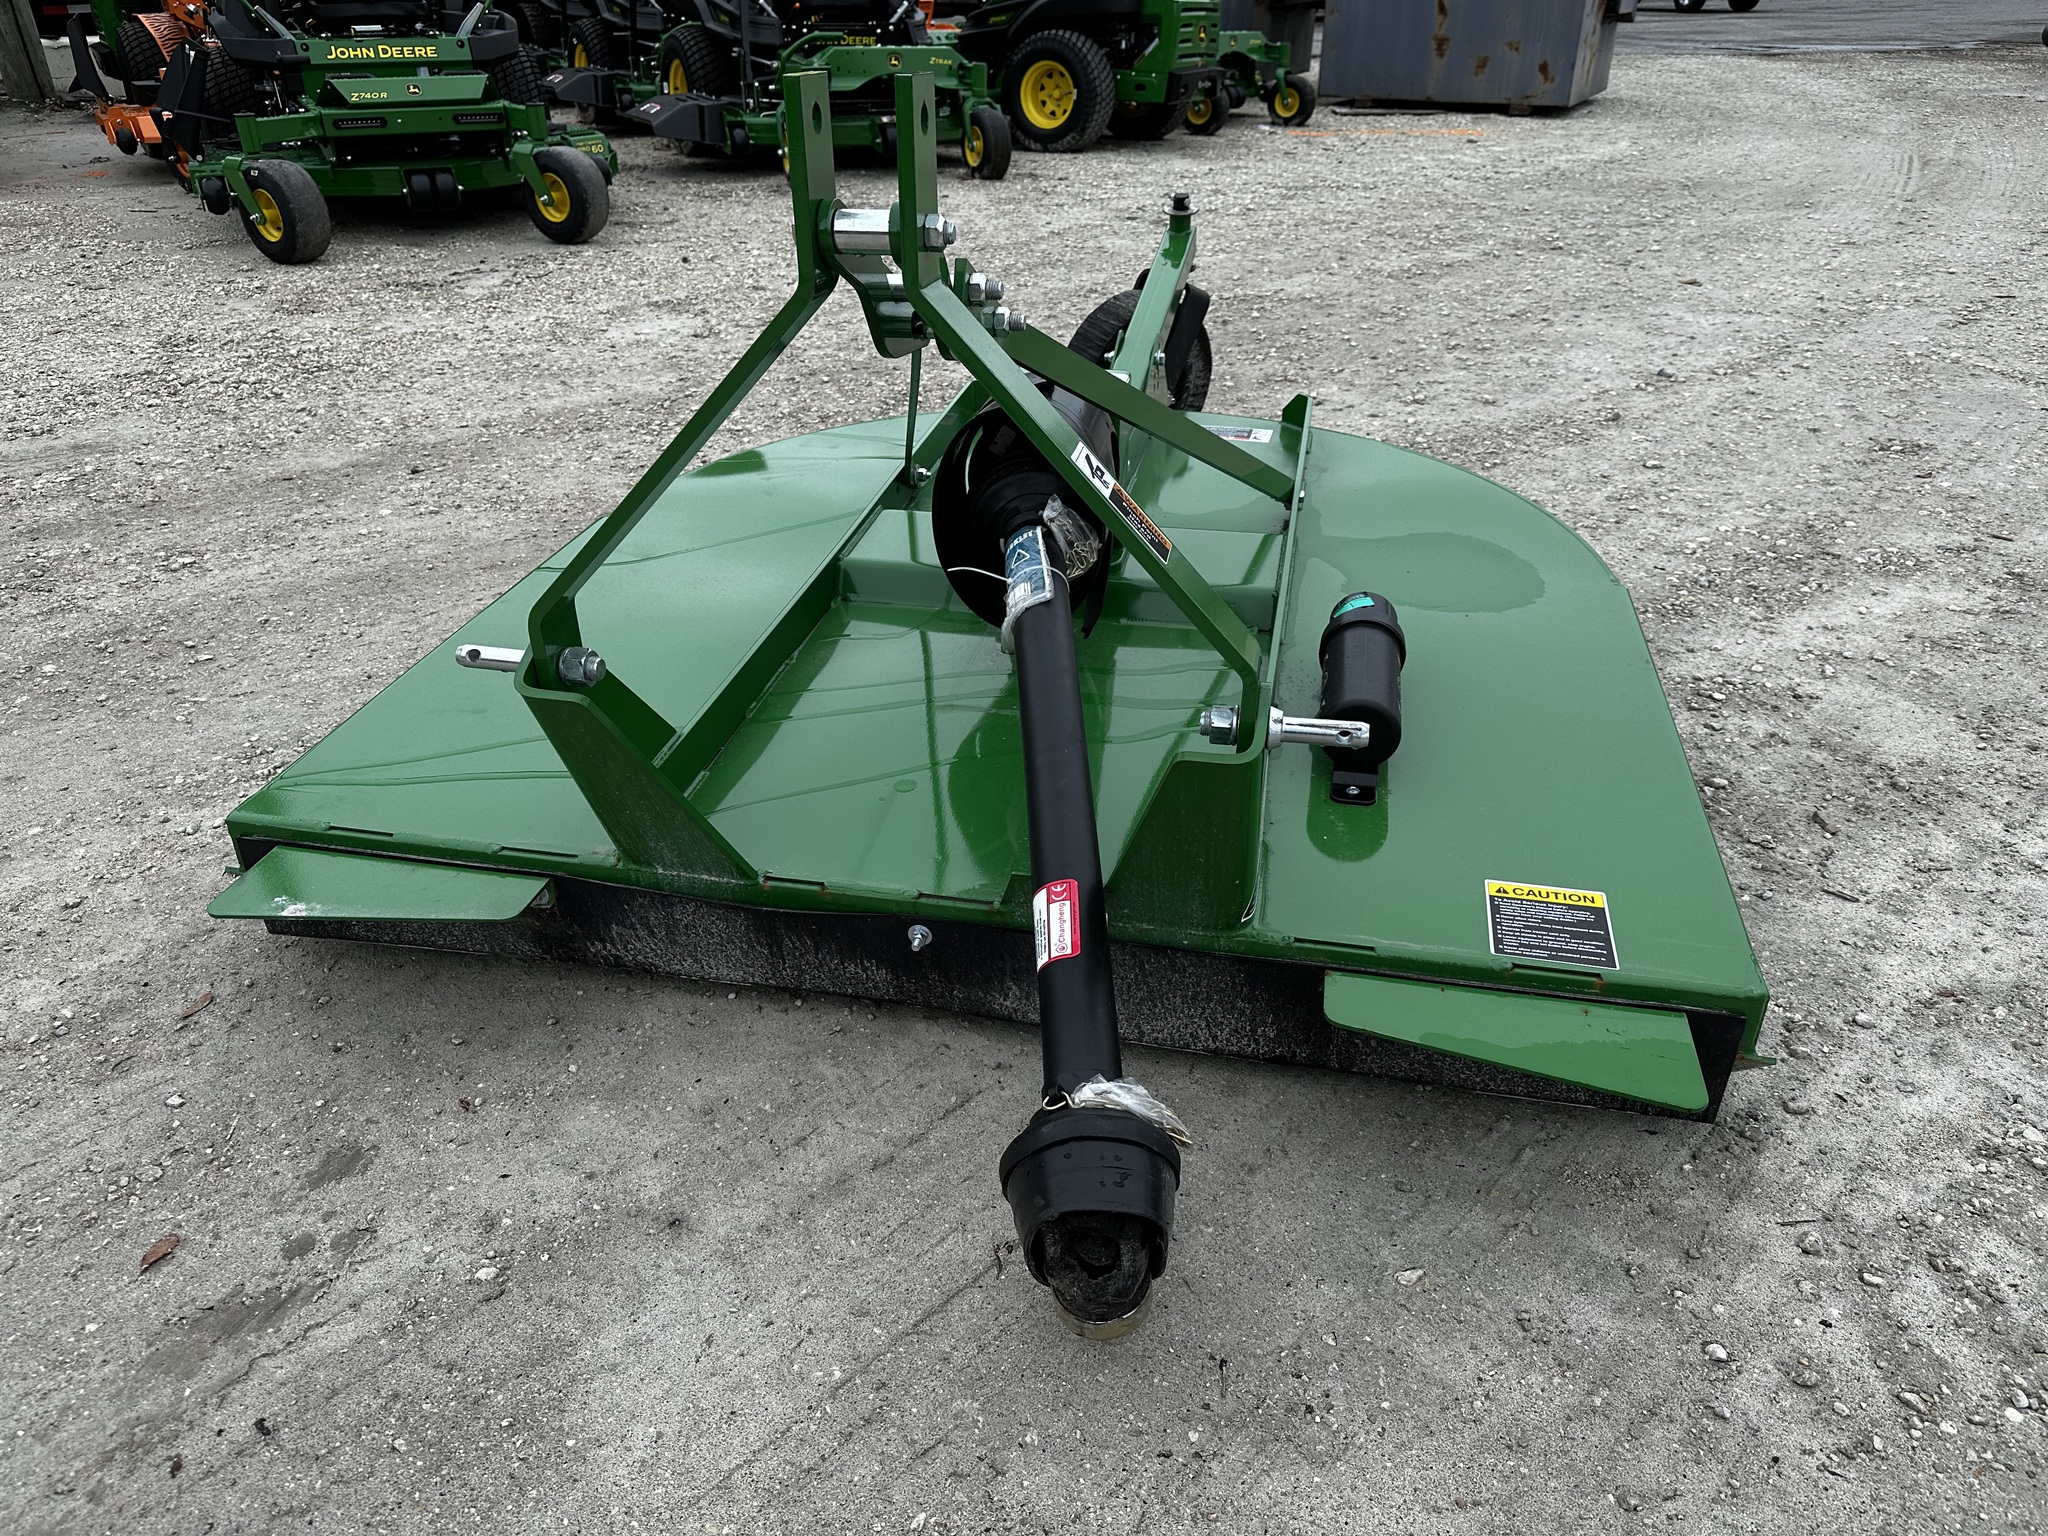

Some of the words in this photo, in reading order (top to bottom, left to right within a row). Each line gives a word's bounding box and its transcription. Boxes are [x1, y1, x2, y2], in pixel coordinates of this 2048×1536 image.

[326, 45, 375, 59] JOHN
[377, 44, 438, 58] DEERE
[591, 144, 604, 153] 60
[1512, 887, 1595, 904] CAUTION
[1057, 902, 1067, 943] Changheng
